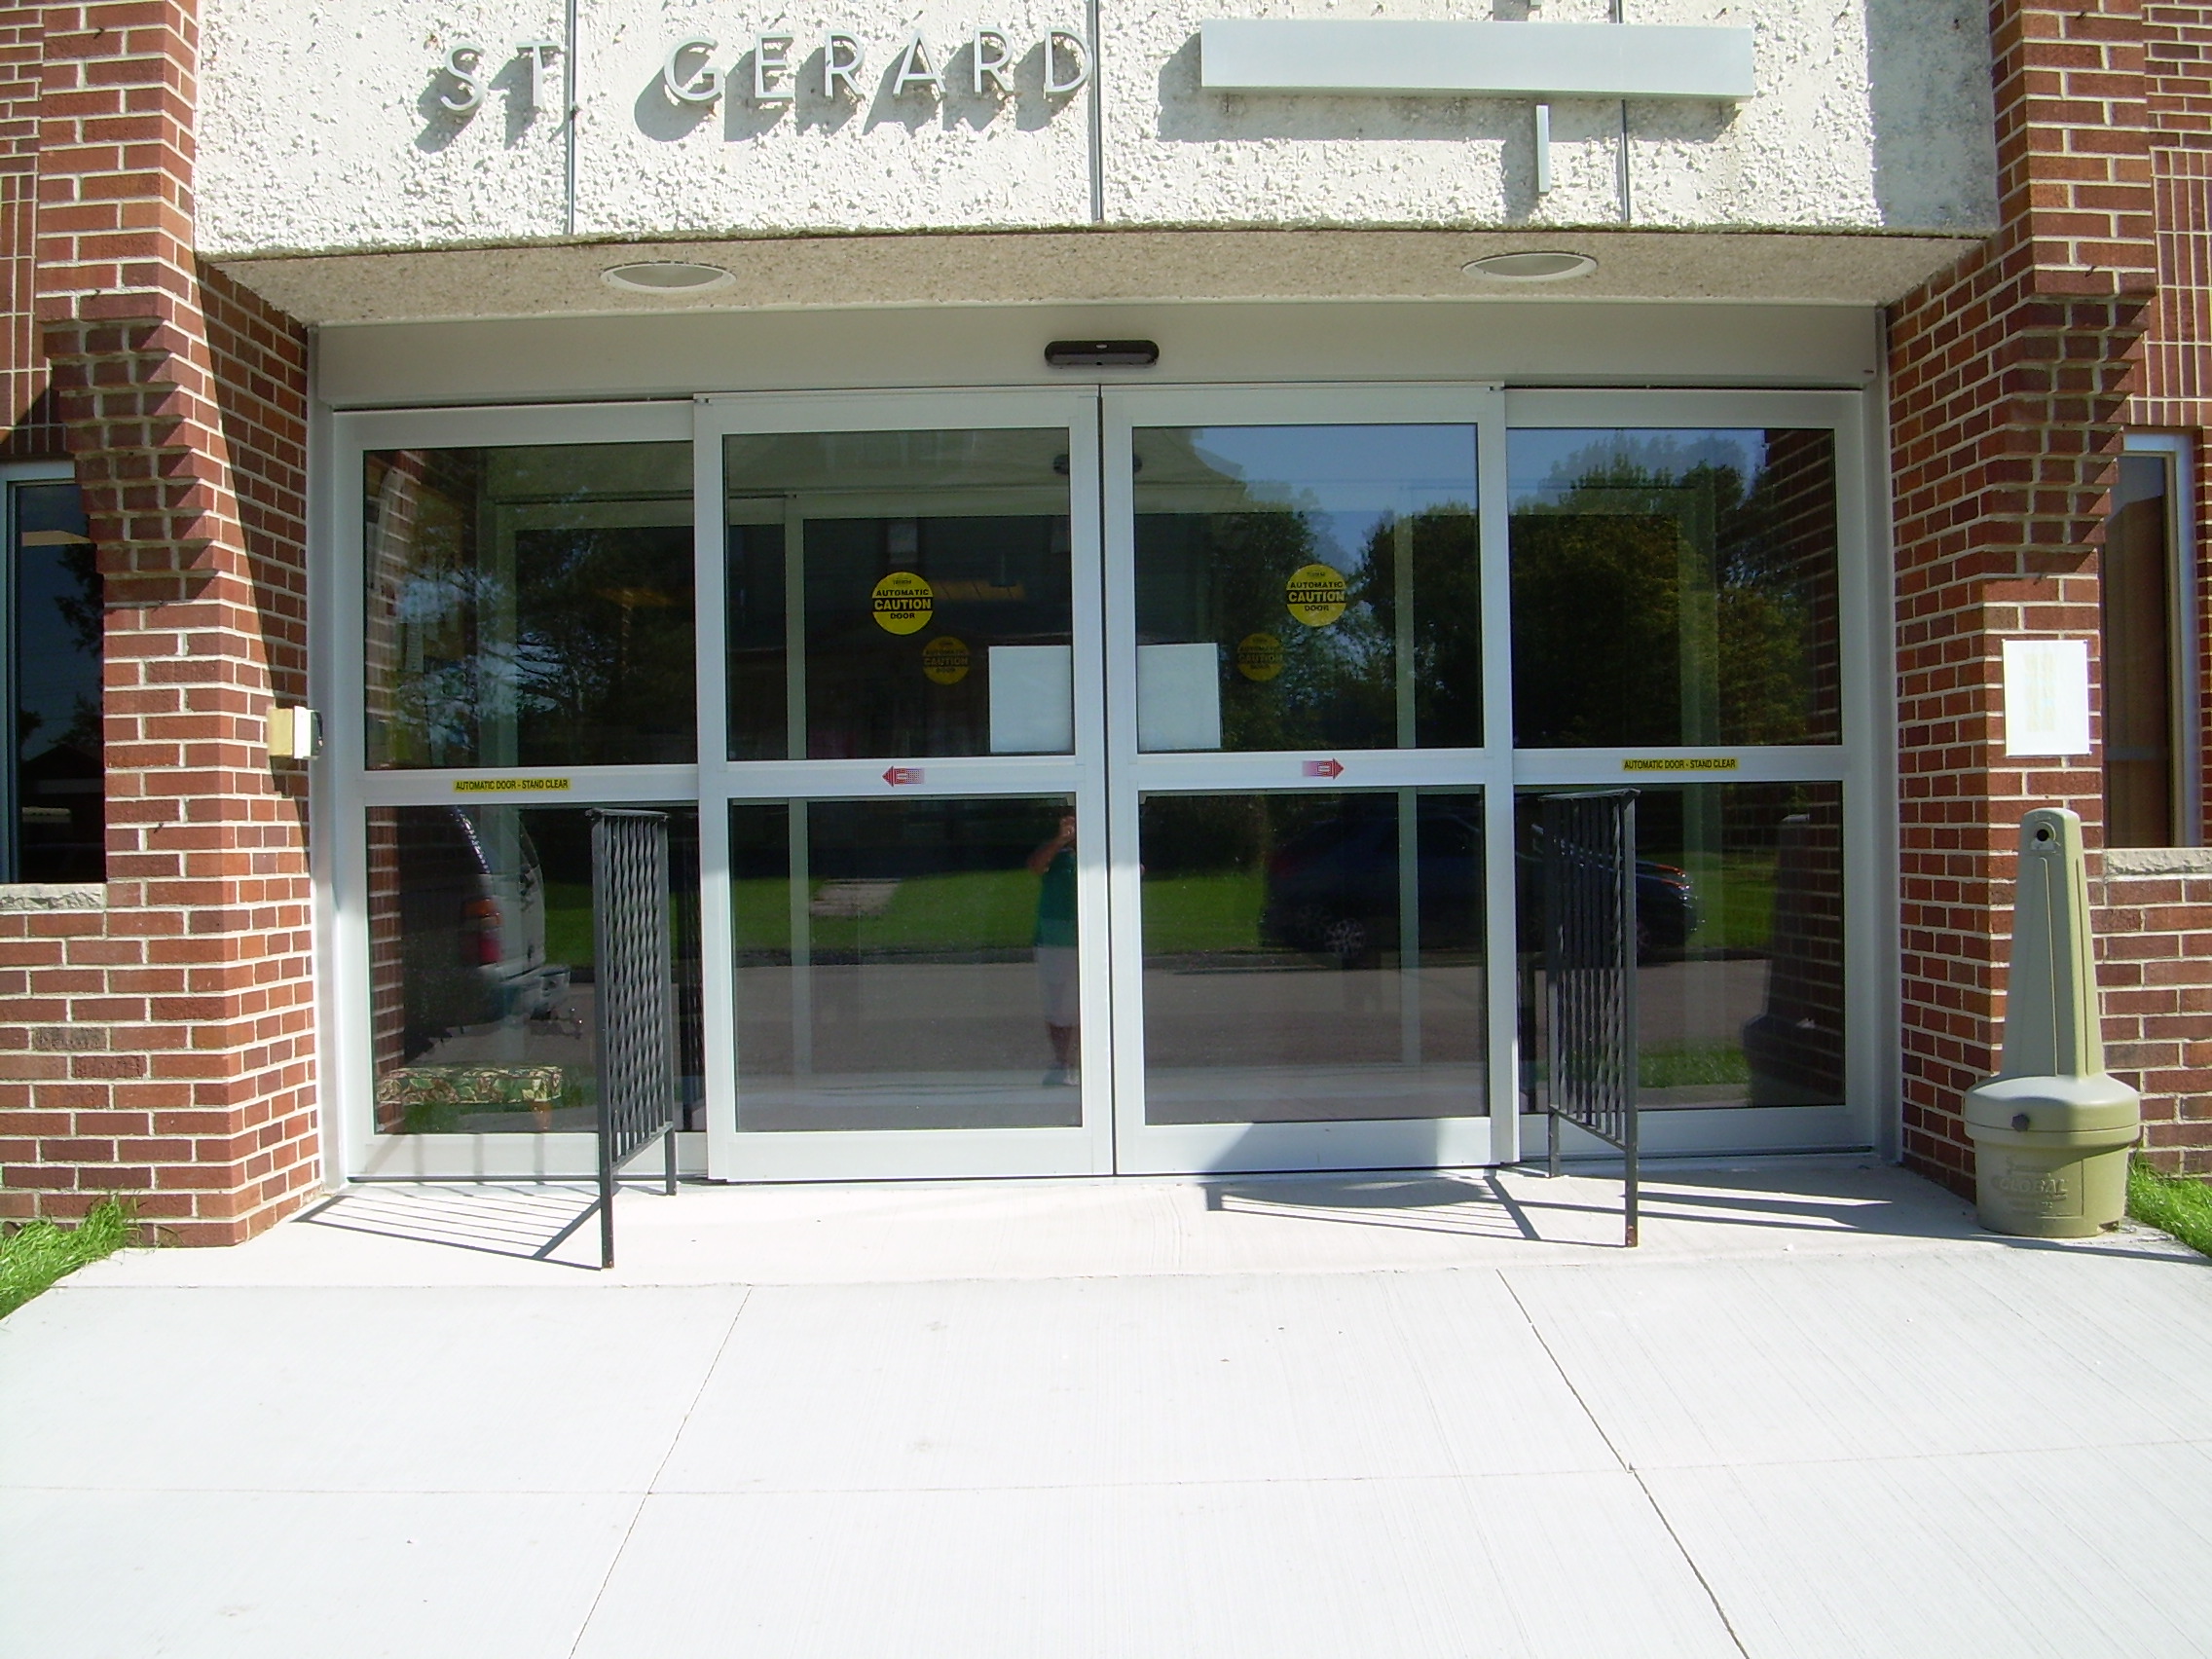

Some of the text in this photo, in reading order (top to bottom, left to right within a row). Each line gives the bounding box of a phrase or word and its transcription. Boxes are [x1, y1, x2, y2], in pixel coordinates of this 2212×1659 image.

[664, 27, 1094, 106] GERARD
[1288, 591, 1346, 603] CAUTION
[874, 599, 932, 610] CAUTION
[924, 657, 968, 666] CAUTION
[1624, 759, 1663, 770] AUTOMATIC
[1664, 759, 1684, 769] DOOR
[1689, 759, 1713, 768] STAND
[1713, 758, 1736, 768] CLEAR
[456, 781, 495, 791] AUTOMATIC
[496, 780, 516, 790] DOOR
[522, 780, 544, 790] STAND
[545, 779, 569, 789] CLEAR
